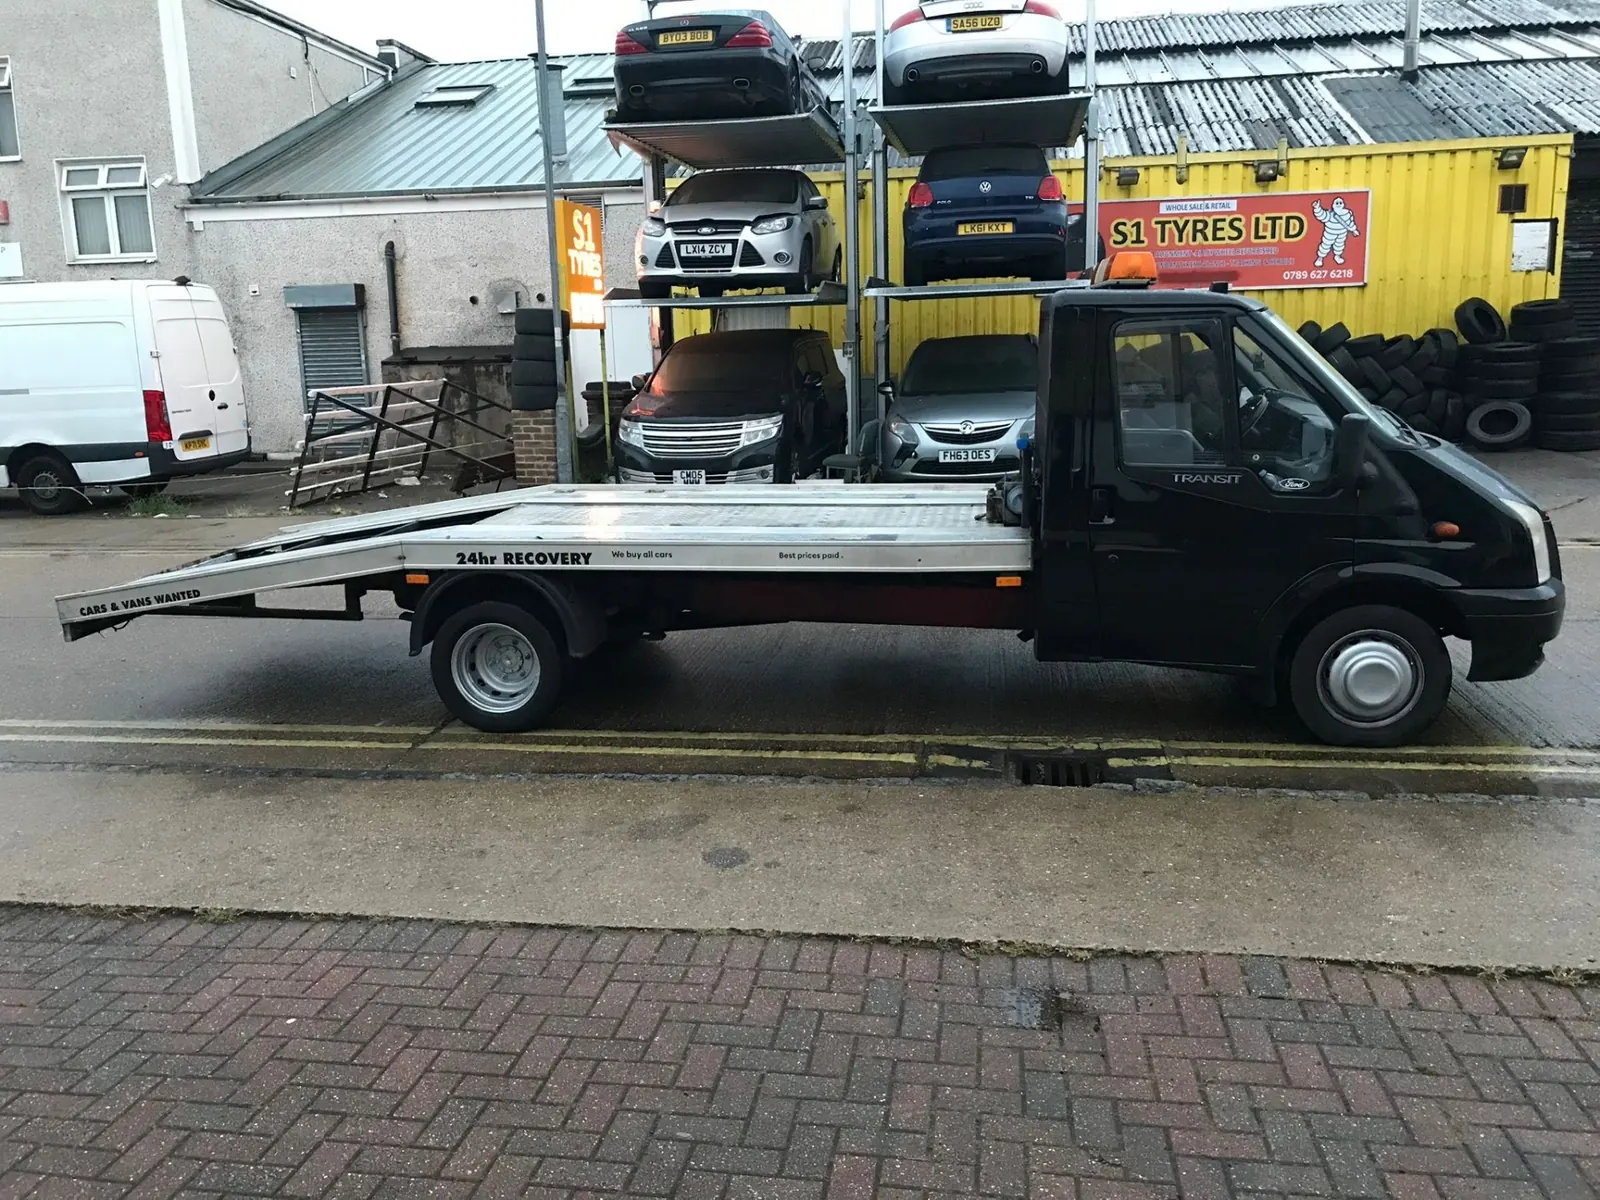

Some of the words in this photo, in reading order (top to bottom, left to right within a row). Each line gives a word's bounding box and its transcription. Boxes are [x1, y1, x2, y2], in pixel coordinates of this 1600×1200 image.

[952, 18, 979, 29] SA56
[663, 32, 687, 43] BY03
[1165, 204, 1188, 212] WHOLE
[1189, 203, 1204, 211] SALE
[573, 209, 596, 252] S1
[963, 224, 986, 234] LK61
[988, 223, 1007, 232] KXT
[1112, 220, 1145, 245] S1
[1154, 217, 1244, 243] TYRES
[1253, 215, 1305, 240] LTD
[685, 245, 706, 254] LX14
[708, 244, 726, 254] ZCY
[1283, 270, 1308, 280] 0789
[1310, 270, 1328, 279] 627
[1330, 269, 1353, 278] 6218
[943, 451, 969, 460] FH63
[971, 450, 990, 459] OES
[1172, 473, 1243, 484] TRANSIT
[456, 552, 497, 565] 24hr
[503, 552, 593, 565] RECOVERY
[626, 551, 642, 560] buy
[643, 551, 653, 559] all
[797, 552, 821, 561] prices
[80, 603, 107, 616] CARS
[110, 602, 119, 611] &
[121, 597, 152, 610] VANS
[153, 589, 201, 604] WANTED
